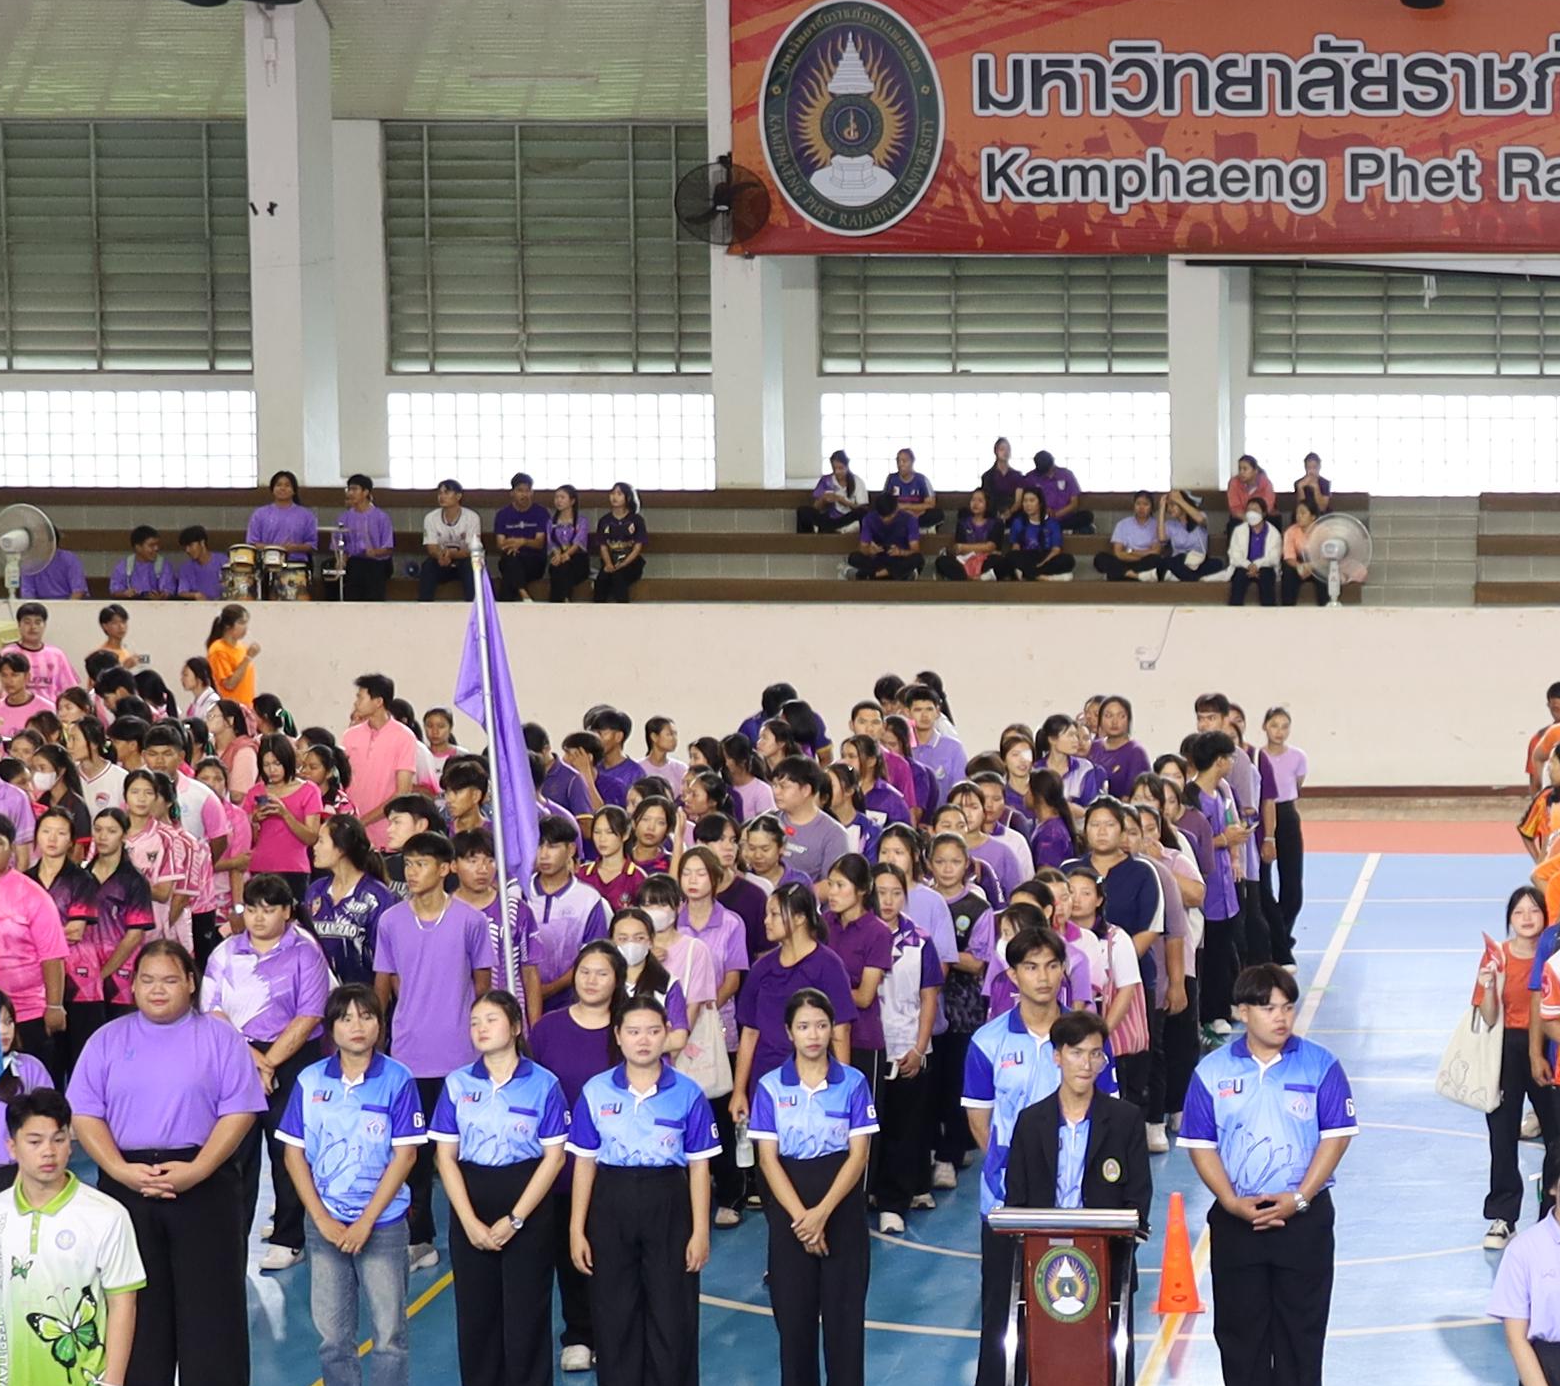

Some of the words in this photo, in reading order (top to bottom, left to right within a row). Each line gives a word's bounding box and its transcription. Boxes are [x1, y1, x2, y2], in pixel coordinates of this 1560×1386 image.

[768, 113, 804, 196] KAMPHAENG
[803, 194, 835, 222] PHET
[838, 192, 906, 229] RAJABHAT
[901, 117, 936, 196] UNIVERSITY
[980, 146, 1324, 213] Kamphaeng
[1344, 146, 1475, 204] Phet
